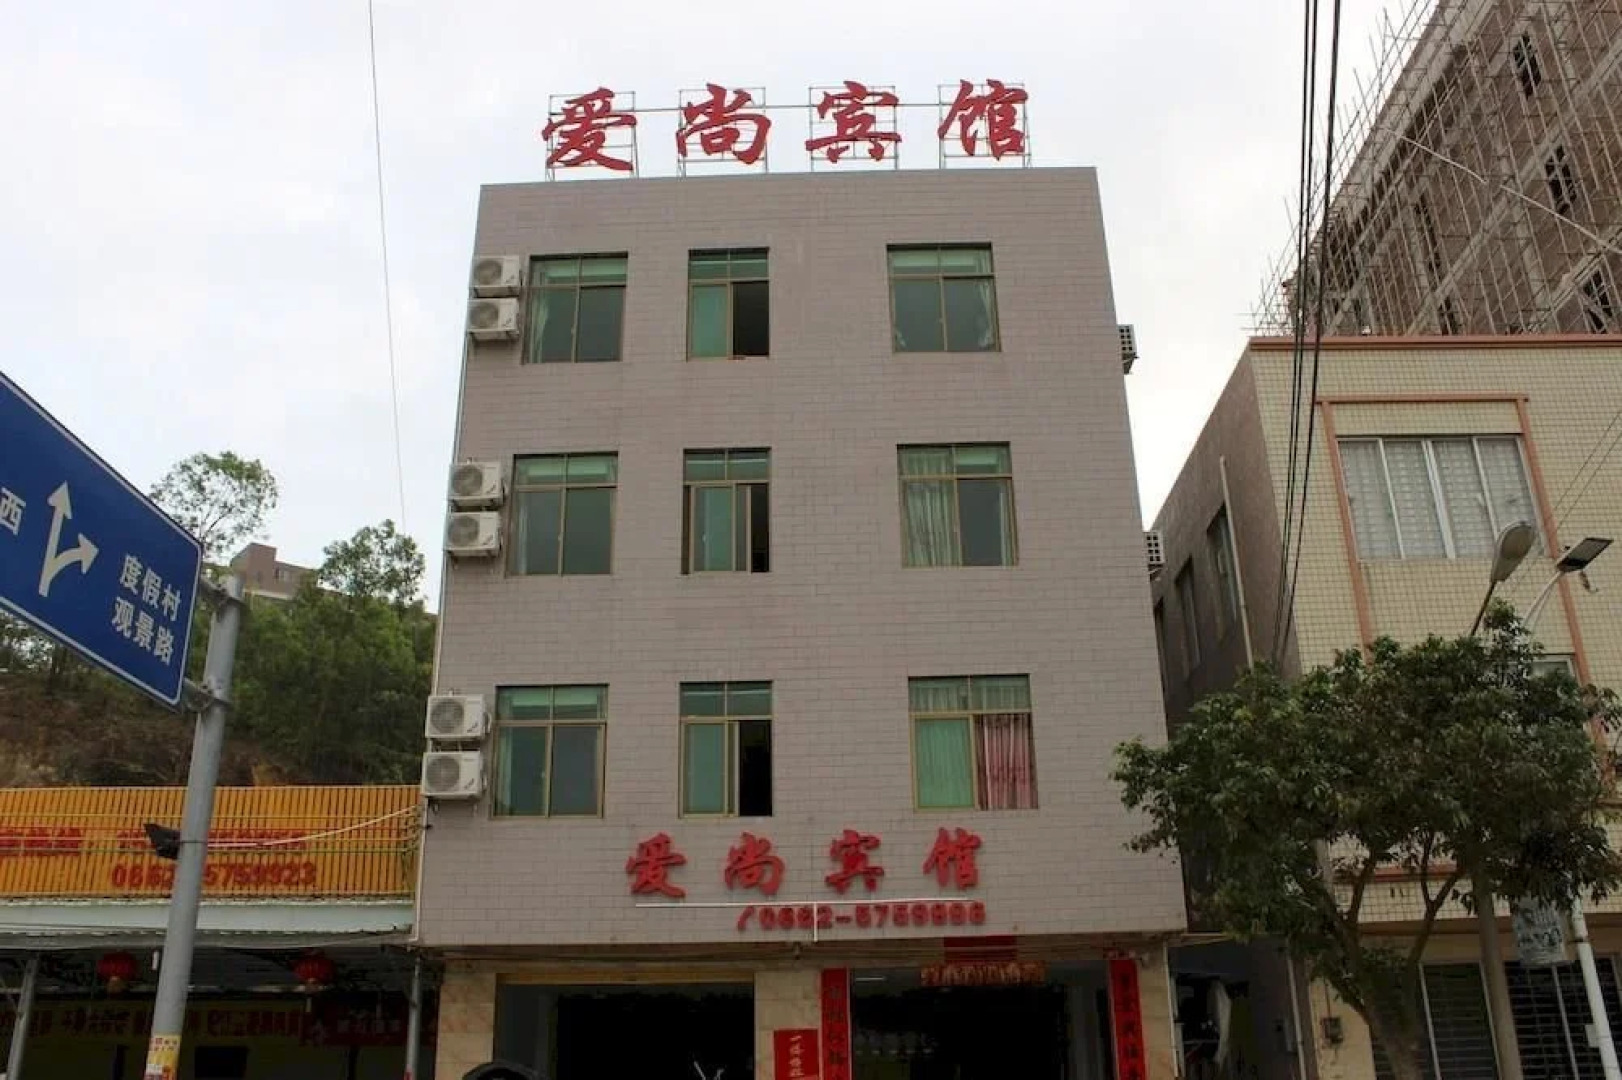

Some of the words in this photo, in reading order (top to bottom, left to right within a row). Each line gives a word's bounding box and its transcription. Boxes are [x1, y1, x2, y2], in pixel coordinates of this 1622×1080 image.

[542, 79, 1028, 171] 爱尚宾馆
[119, 554, 181, 621] 度假村
[111, 596, 175, 664] 观景路
[626, 827, 983, 898] 爱尚宾馆
